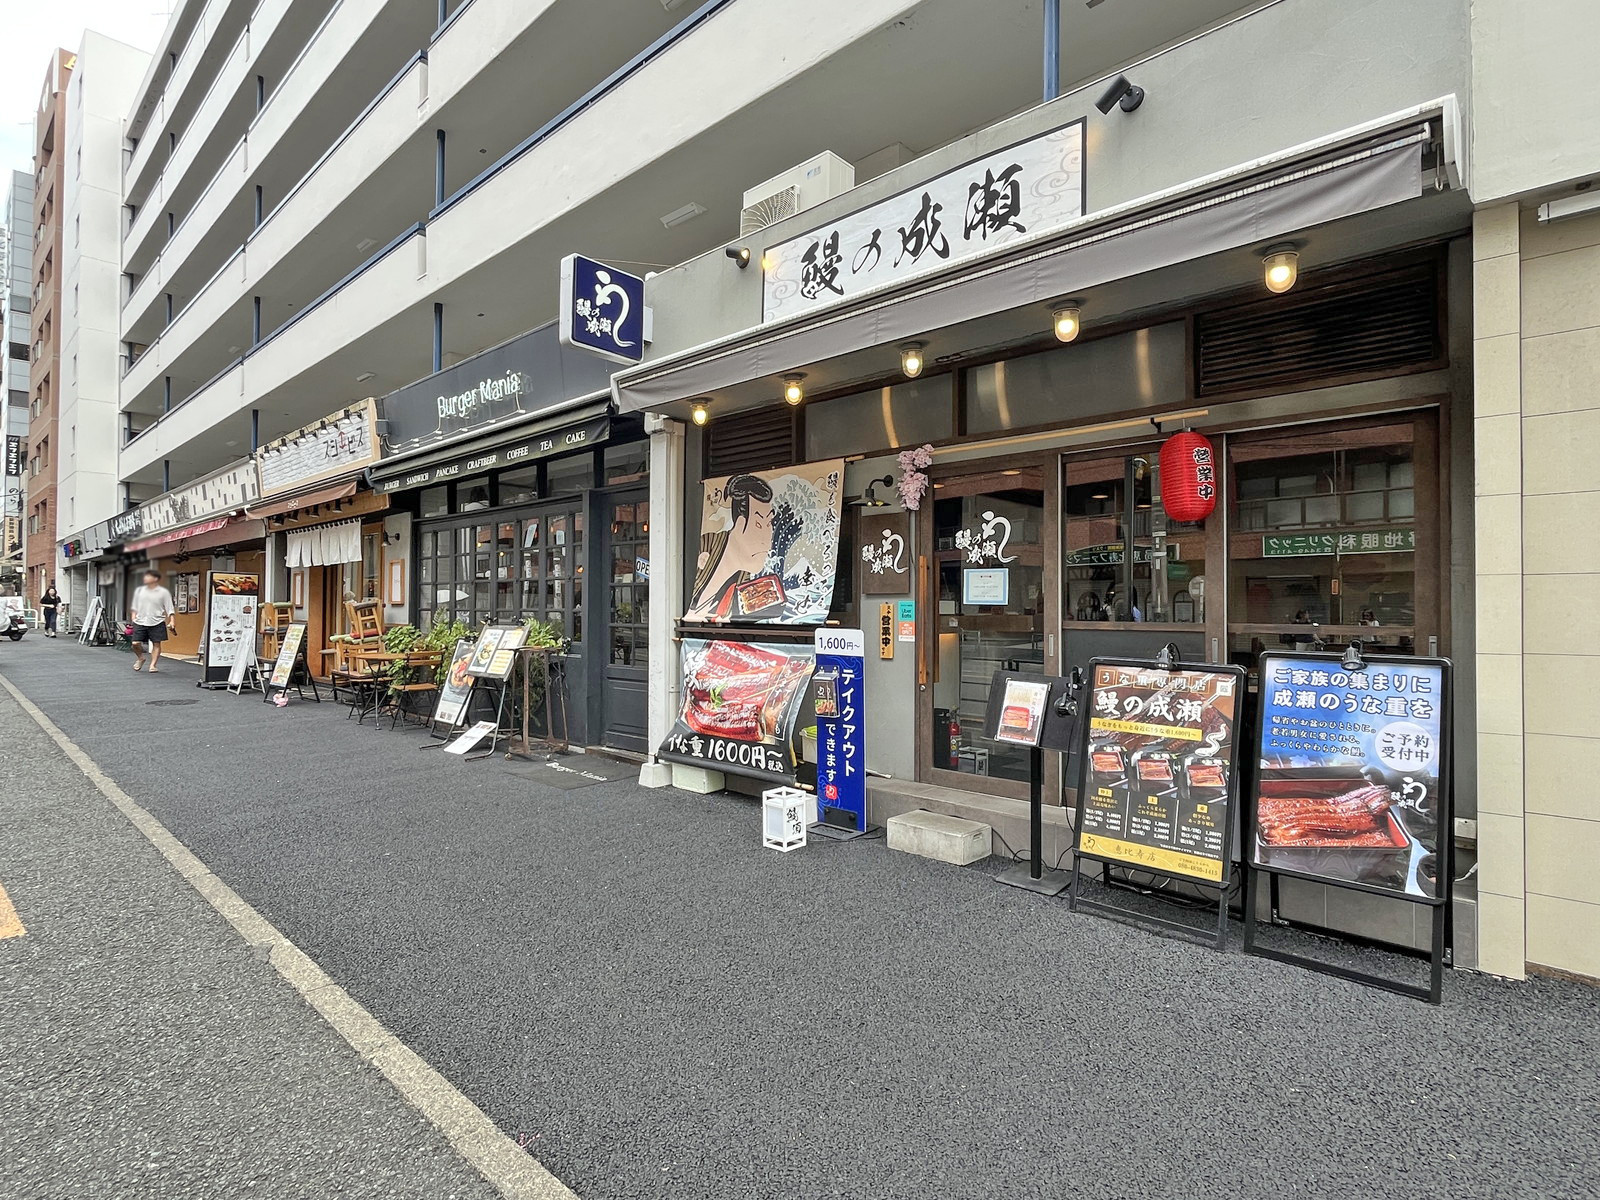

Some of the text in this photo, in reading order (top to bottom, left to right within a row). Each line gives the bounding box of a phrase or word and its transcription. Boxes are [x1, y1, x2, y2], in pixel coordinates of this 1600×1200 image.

[800, 163, 1027, 300] 鰻の成瀬
[437, 369, 521, 418] Burger Mania
[384, 430, 586, 491] BURGER SANDWICH PANCAKE CRAFTBEER COFFEE TEA CAKE
[1193, 447, 1215, 500] 営業中
[636, 560, 650, 575] OPE
[818, 636, 861, 650] 1,600円～
[881, 615, 891, 647] 営業中
[1102, 671, 1207, 692] うな重専門店
[1274, 668, 1432, 693] ご家族の集まりに
[1095, 690, 1203, 723] 鰻の成瀬
[1272, 689, 1433, 719] 成瀬のうな重を
[841, 668, 856, 777] テイクアウト
[1271, 728, 1361, 744] 老若男女に愛される、
[1272, 716, 1377, 734] 帰省やお盆のひとときに。
[825, 723, 837, 782] できます
[1382, 732, 1430, 748] ご予約
[1381, 746, 1430, 763] 受付中
[1113, 844, 1156, 862] 恵比寿店
